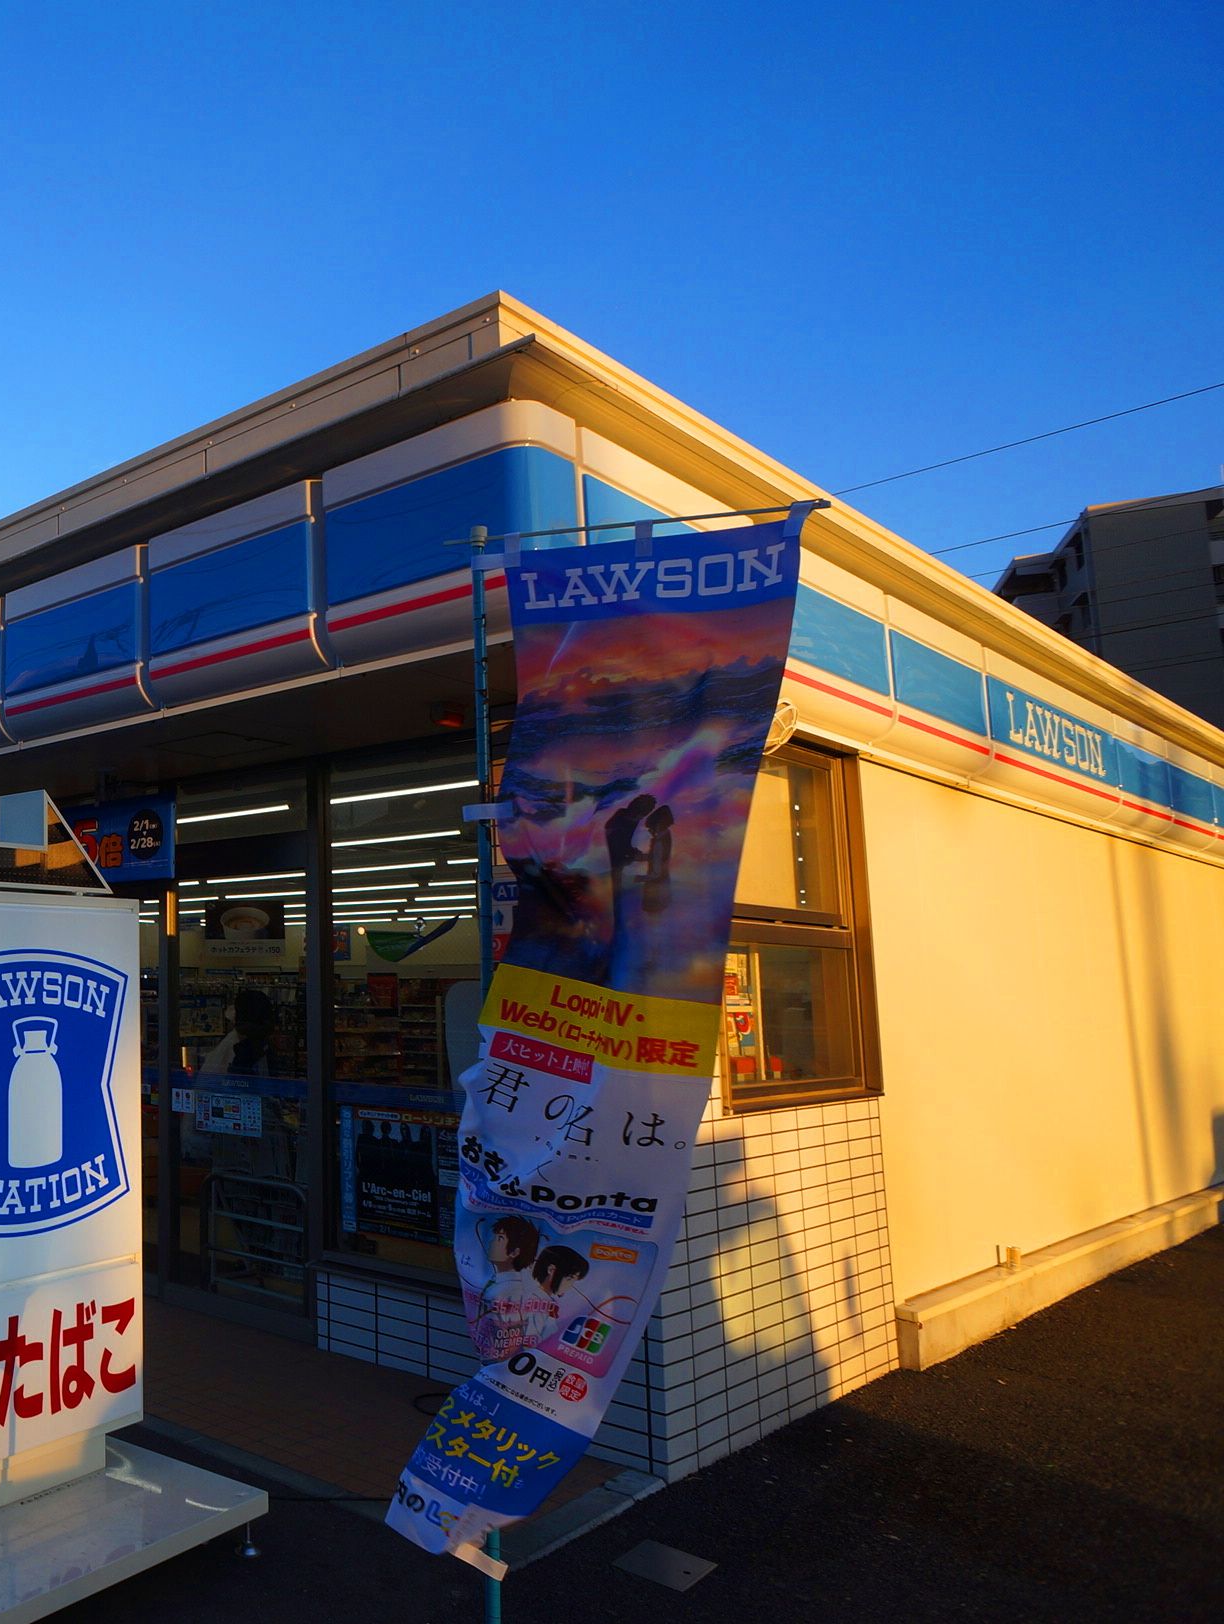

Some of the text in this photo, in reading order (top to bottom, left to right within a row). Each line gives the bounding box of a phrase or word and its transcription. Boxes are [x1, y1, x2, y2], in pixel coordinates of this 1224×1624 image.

[520, 541, 786, 611] LAWSON
[1006, 691, 1107, 777] LAWSON
[494, 1335, 537, 1349] MEMBER
[565, 1325, 606, 1347] JCB
[556, 1343, 595, 1366] PREPAID
[560, 1385, 583, 1402] 限定
